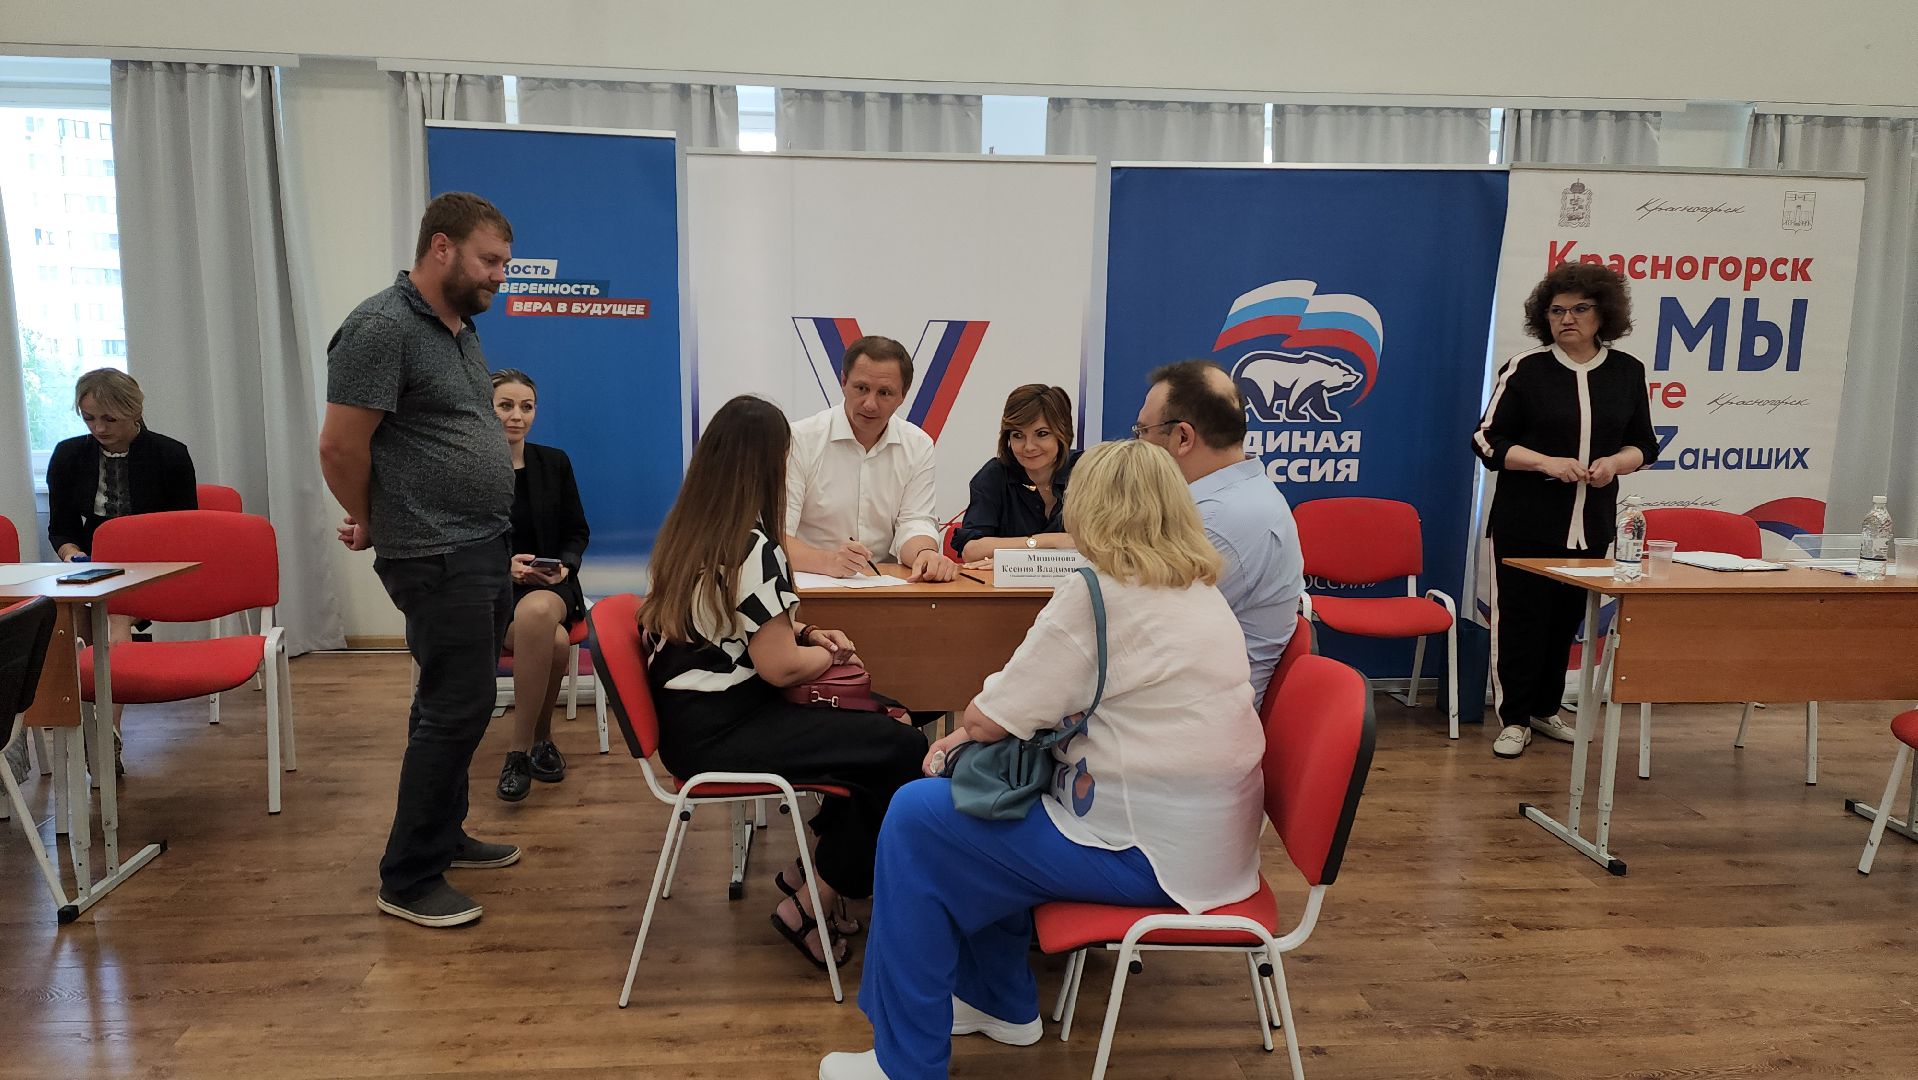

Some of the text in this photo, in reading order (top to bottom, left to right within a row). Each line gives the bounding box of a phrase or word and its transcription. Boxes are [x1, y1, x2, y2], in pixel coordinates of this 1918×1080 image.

[512, 301, 645, 316] ВЕРА В БУДУЩЕЕ
[1653, 297, 1809, 372] МЫ
